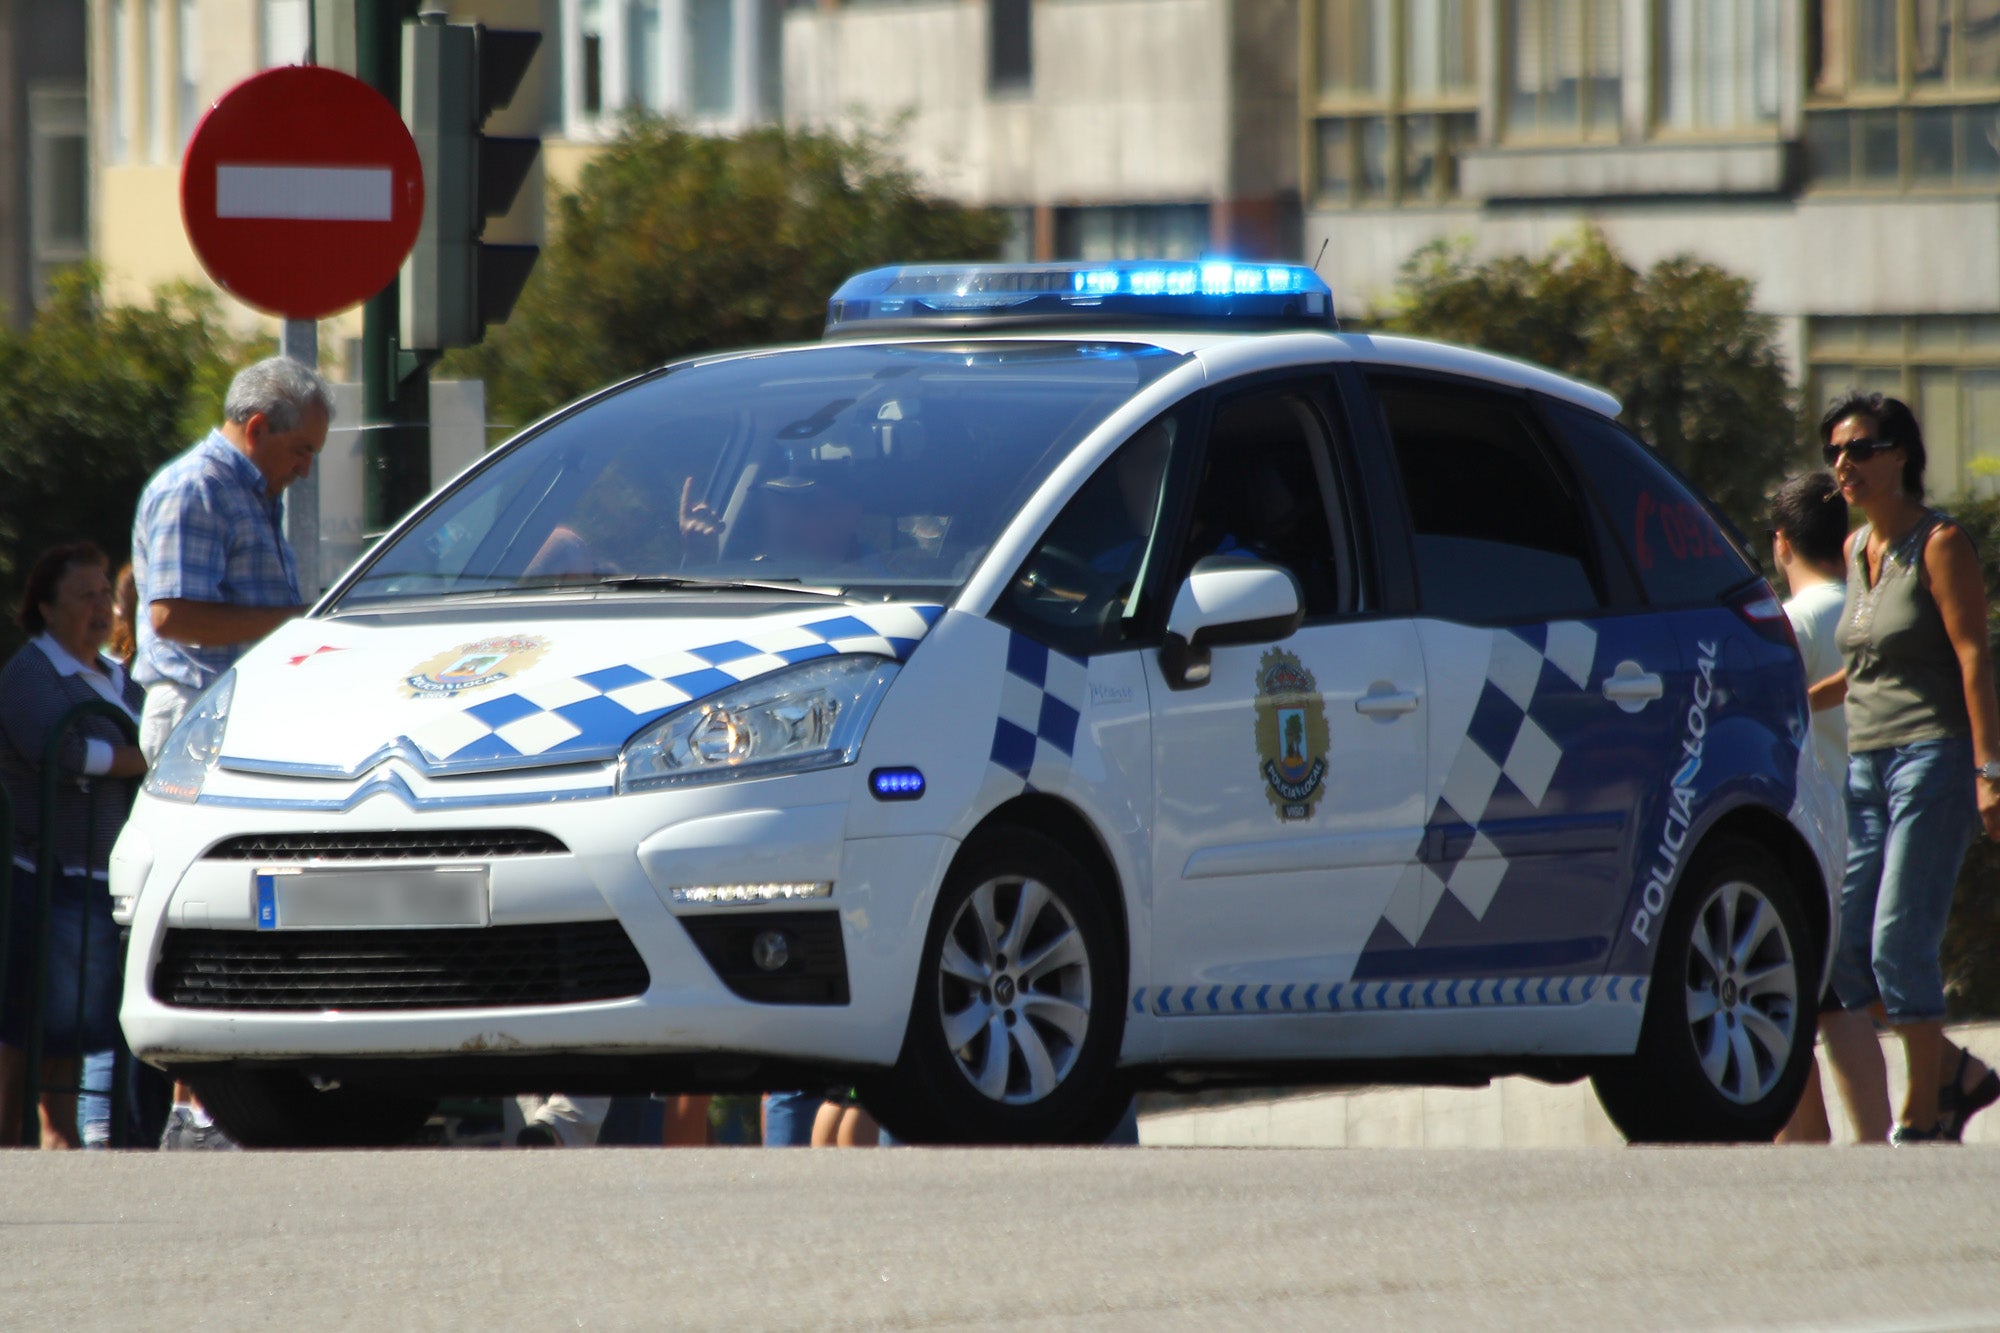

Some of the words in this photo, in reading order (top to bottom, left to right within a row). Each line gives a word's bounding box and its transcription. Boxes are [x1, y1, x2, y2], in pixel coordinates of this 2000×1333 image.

[1268, 764, 1297, 799] POLICIA
[1302, 763, 1323, 796] LOCAL
[1631, 786, 1696, 946] POLICIA
[1682, 640, 1717, 758] LOCAL
[1286, 806, 1305, 817] VIGO
[262, 906, 272, 920] E
